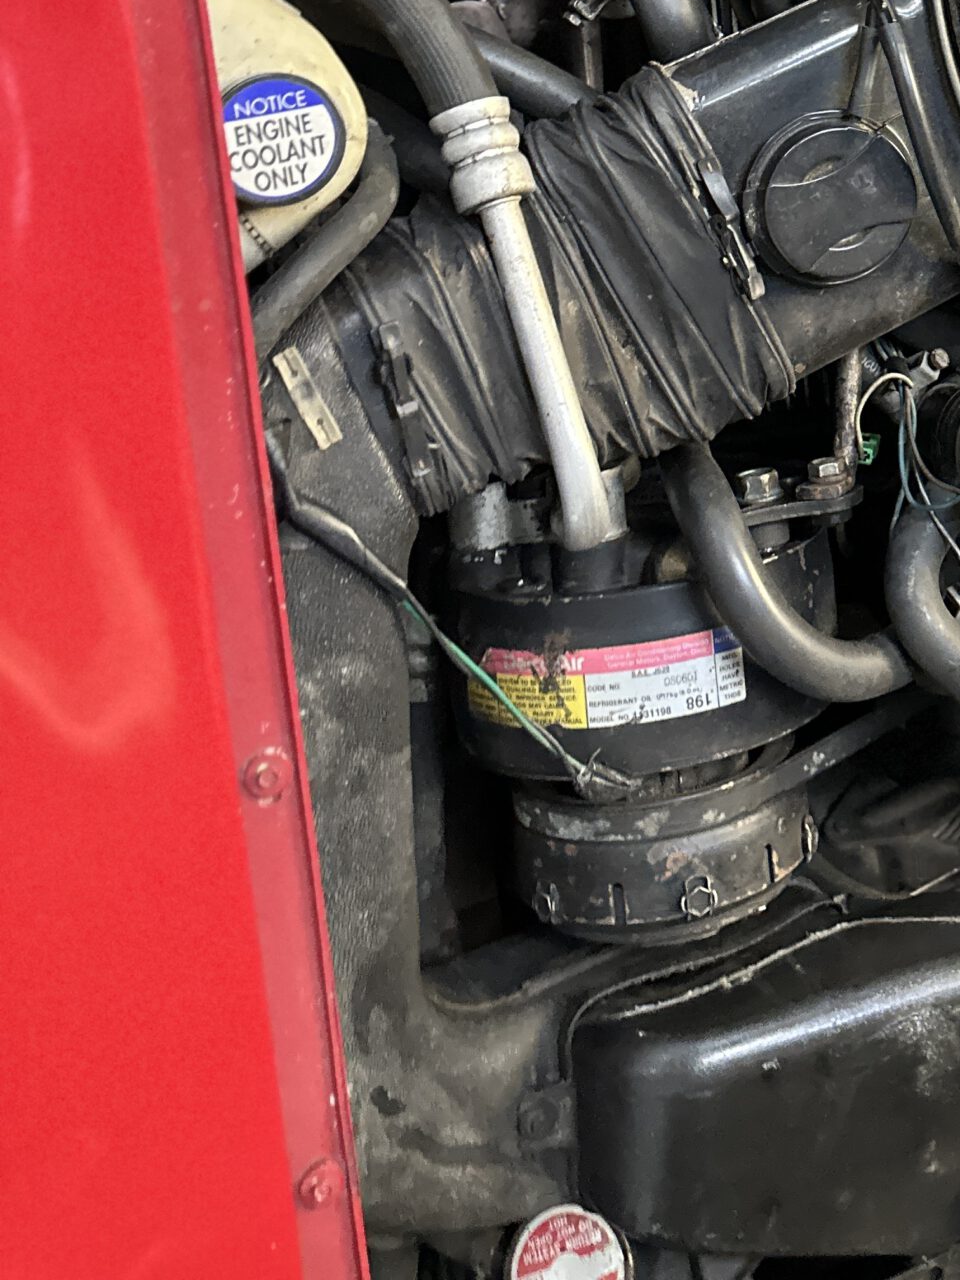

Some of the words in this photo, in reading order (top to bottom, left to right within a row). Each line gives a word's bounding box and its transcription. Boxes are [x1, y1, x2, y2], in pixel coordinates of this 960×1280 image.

[233, 89, 308, 119] NOTICE
[234, 112, 313, 147] ENGINE
[229, 134, 326, 173] COOLANT
[254, 162, 308, 192] ONLY
[588, 697, 638, 709] REFRIGERANT
[590, 715, 615, 726] MODEL
